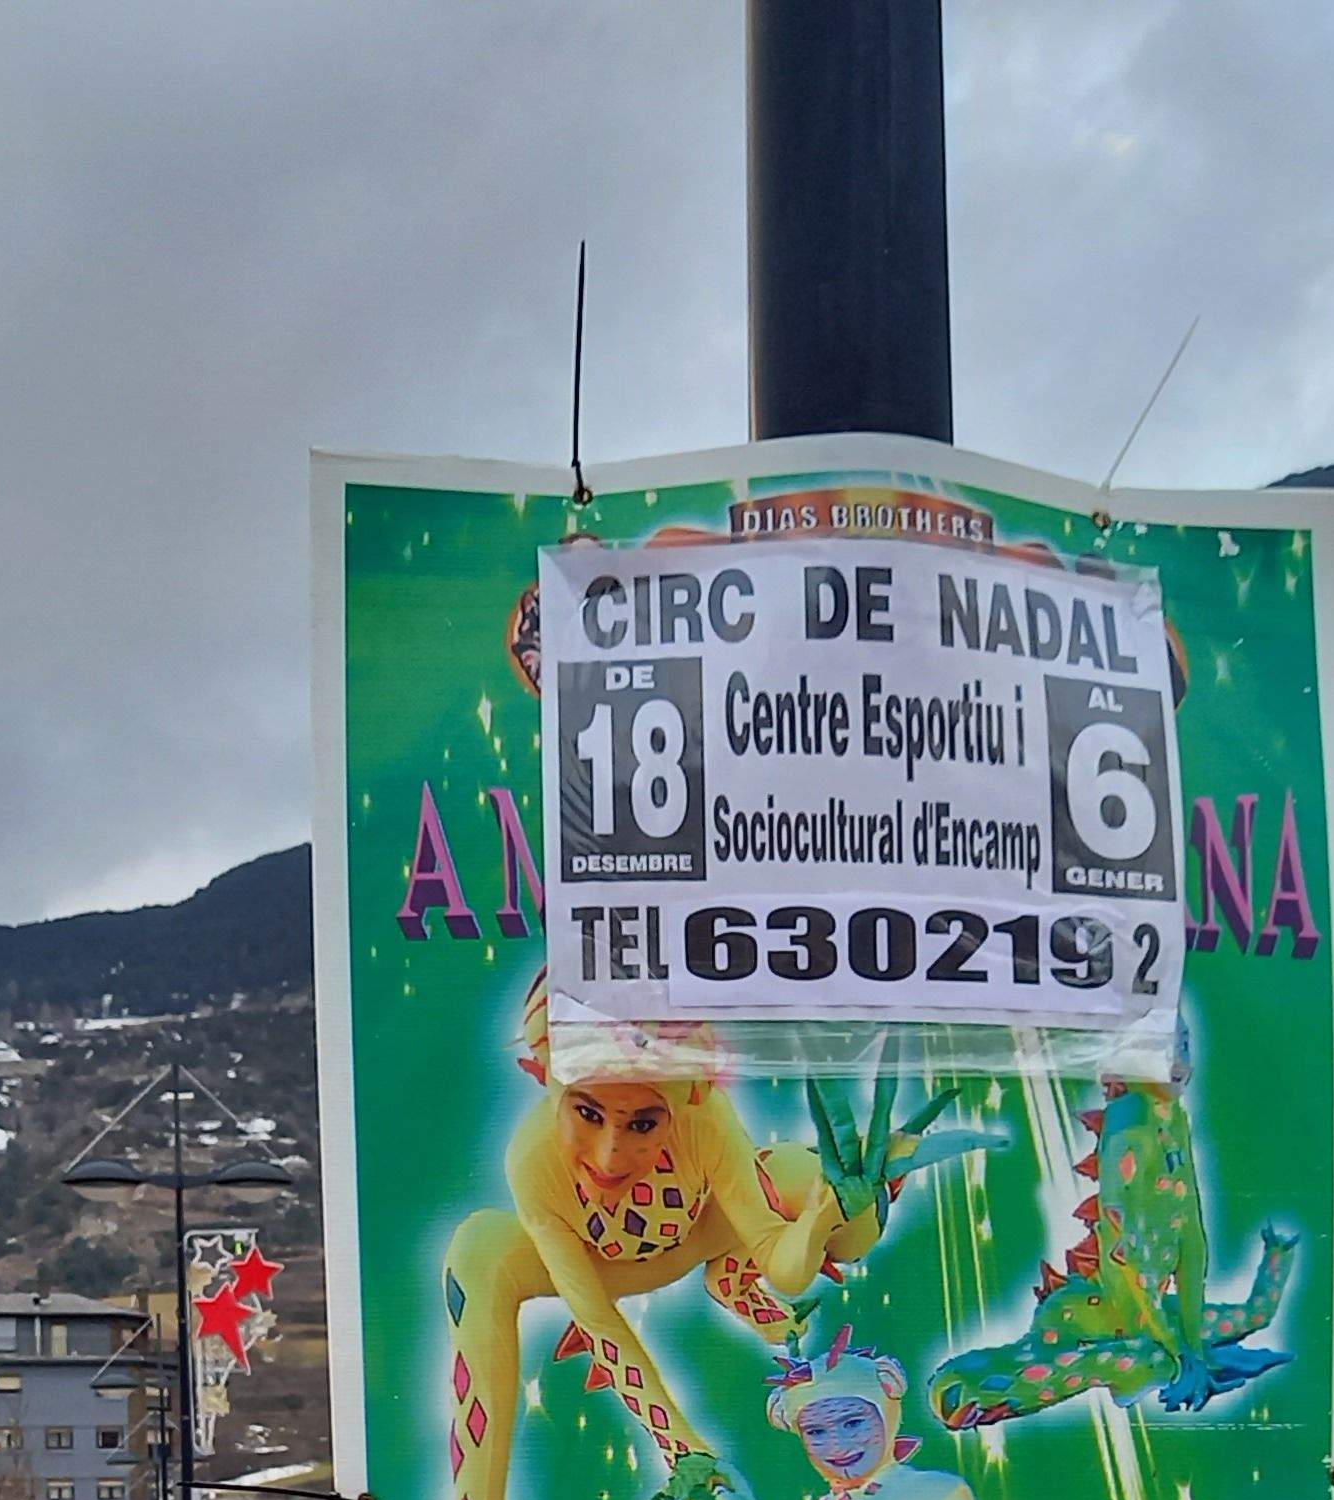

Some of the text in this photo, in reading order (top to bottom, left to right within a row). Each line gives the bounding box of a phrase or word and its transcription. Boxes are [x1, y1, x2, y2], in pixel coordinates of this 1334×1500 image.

[742, 503, 985, 543] DIAS BROTHERS
[582, 565, 1139, 675] CIRC DE NADAL
[605, 664, 656, 691] DE
[1087, 686, 1124, 714] AL
[576, 698, 689, 839] 18
[725, 670, 1025, 783] Centre Esportiu i
[1067, 721, 1158, 861] 6
[571, 853, 694, 875] DESEMBRE
[713, 793, 1041, 891] Sociocultural d'Encamp
[1066, 865, 1166, 893] GENER
[570, 905, 670, 982] TEL
[683, 904, 1114, 990] 630219
